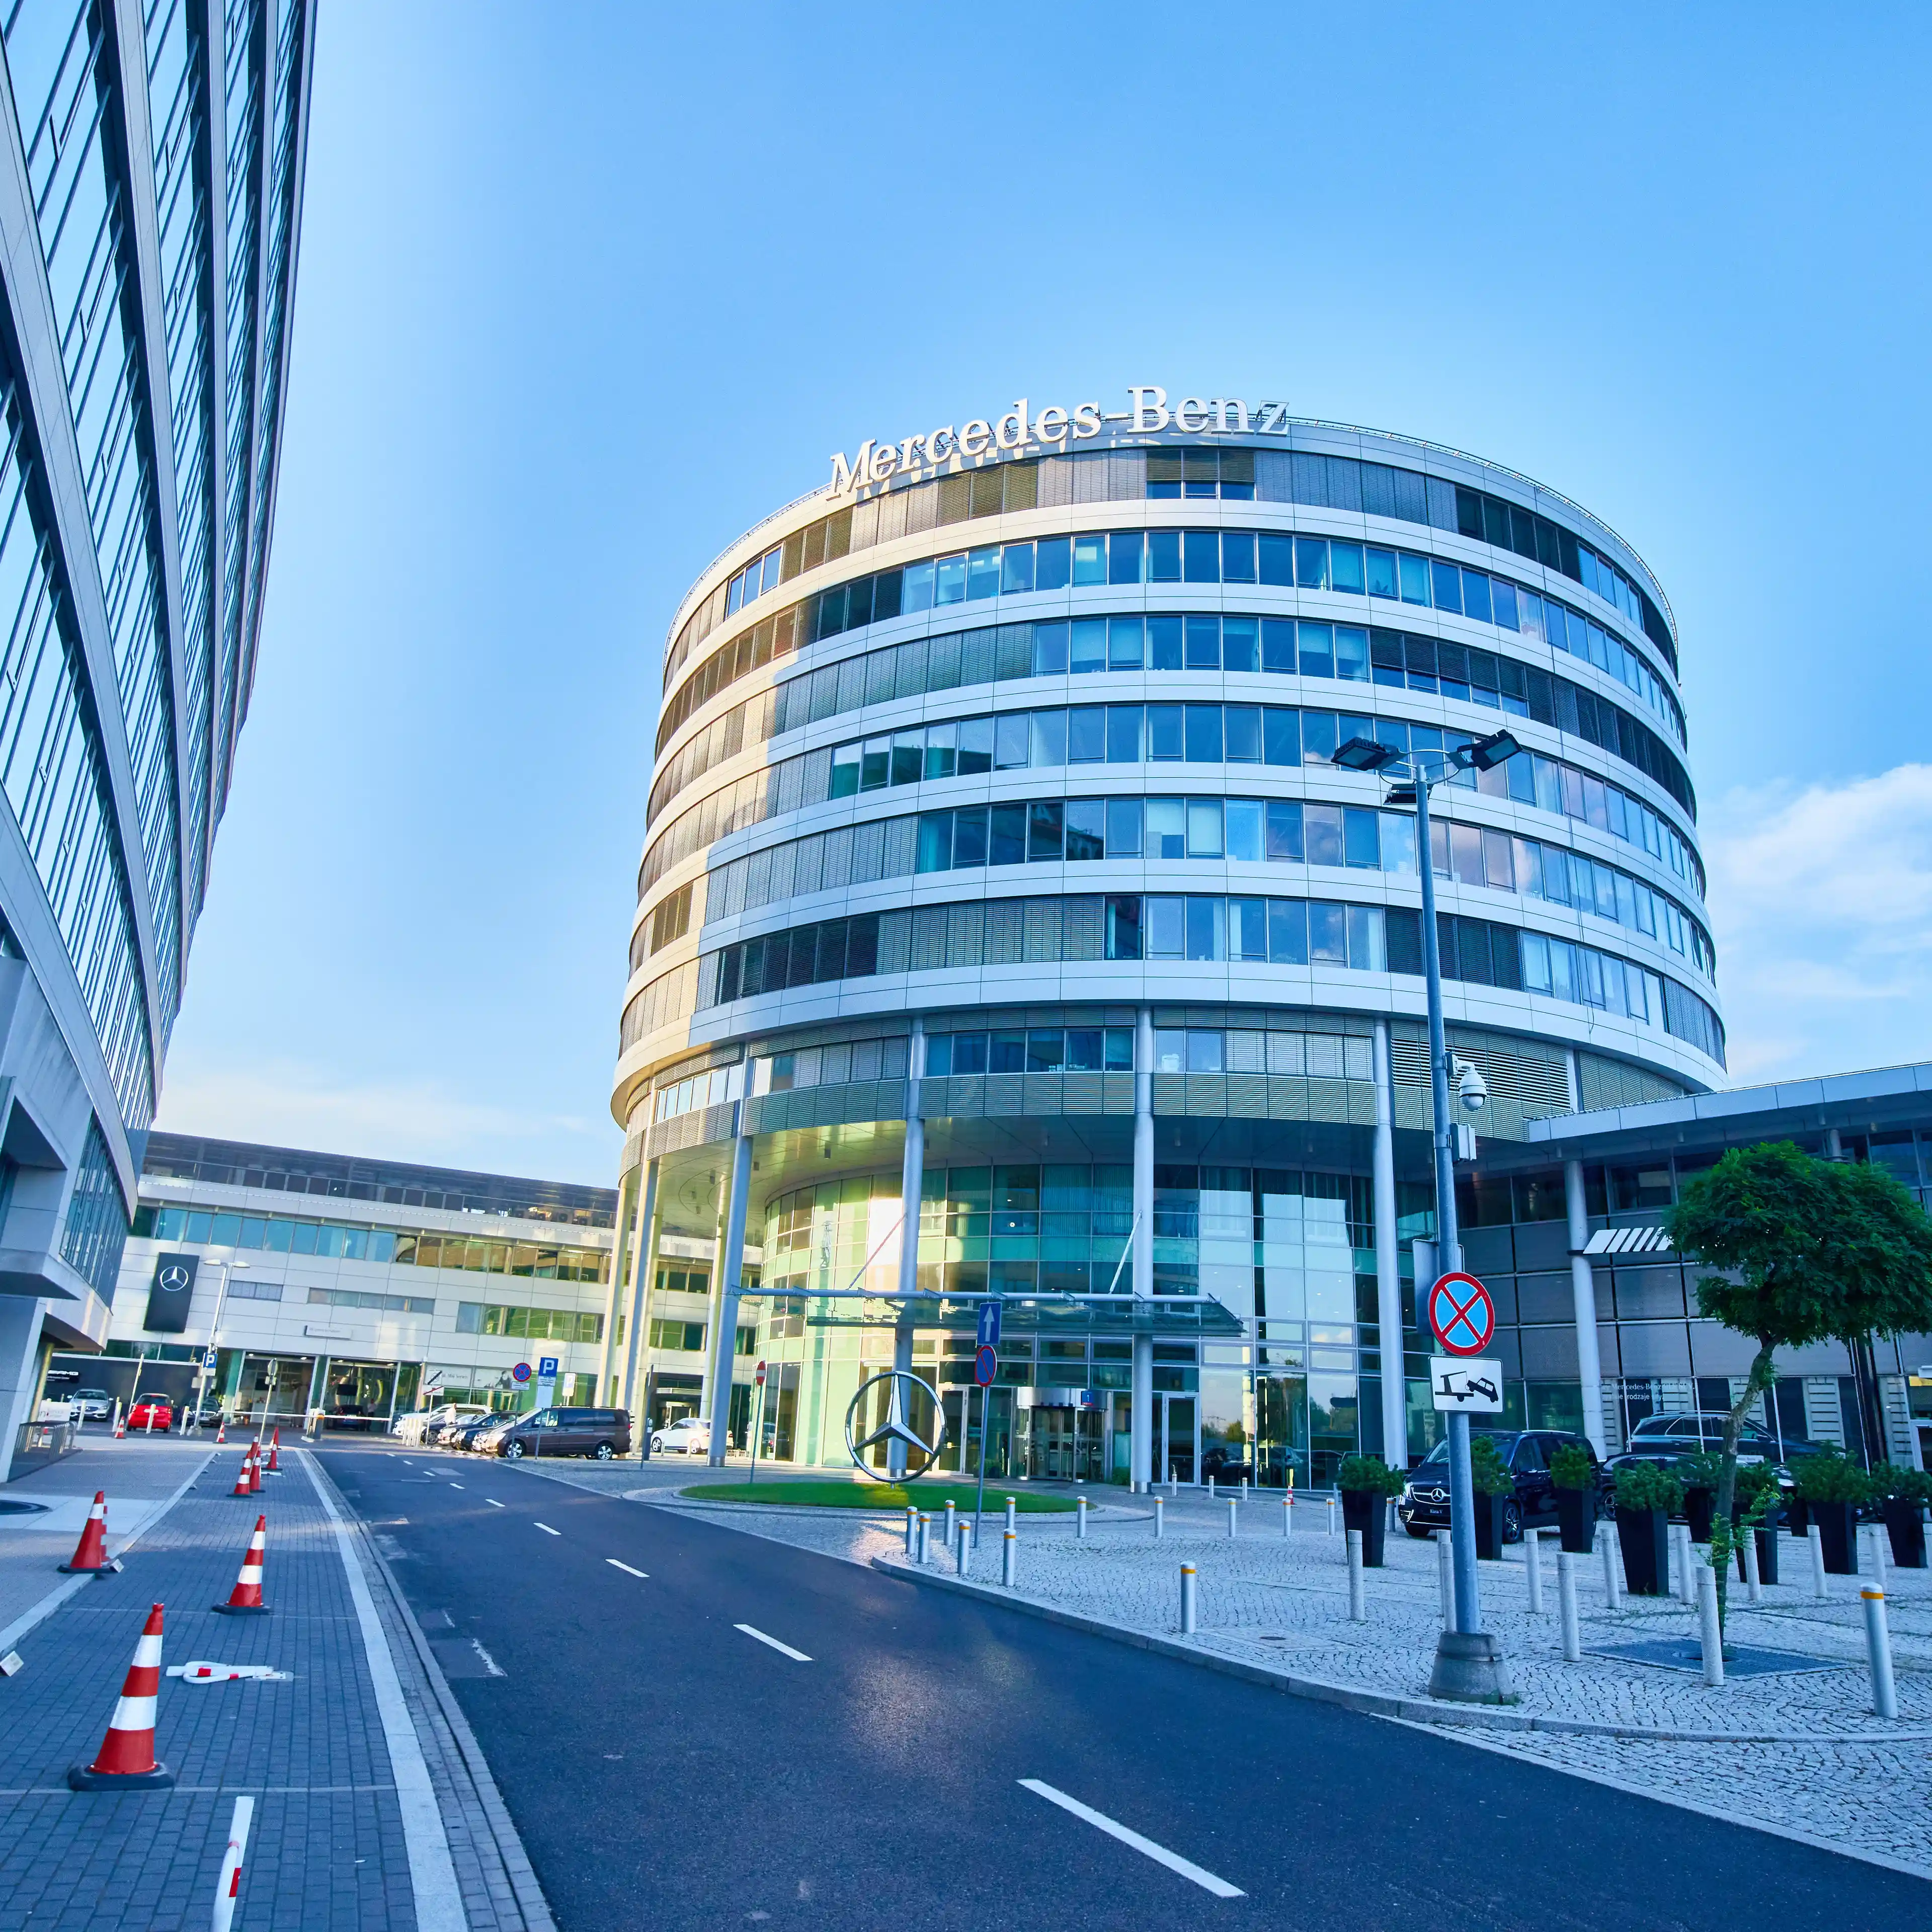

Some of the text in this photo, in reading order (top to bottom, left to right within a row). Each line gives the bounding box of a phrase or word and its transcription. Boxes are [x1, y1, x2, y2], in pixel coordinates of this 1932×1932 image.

[826, 386, 1290, 502] Mercedes-Benz
[205, 1354, 215, 1366] P
[543, 1359, 555, 1374] P
[1627, 1393, 1650, 1401] rodzaje
